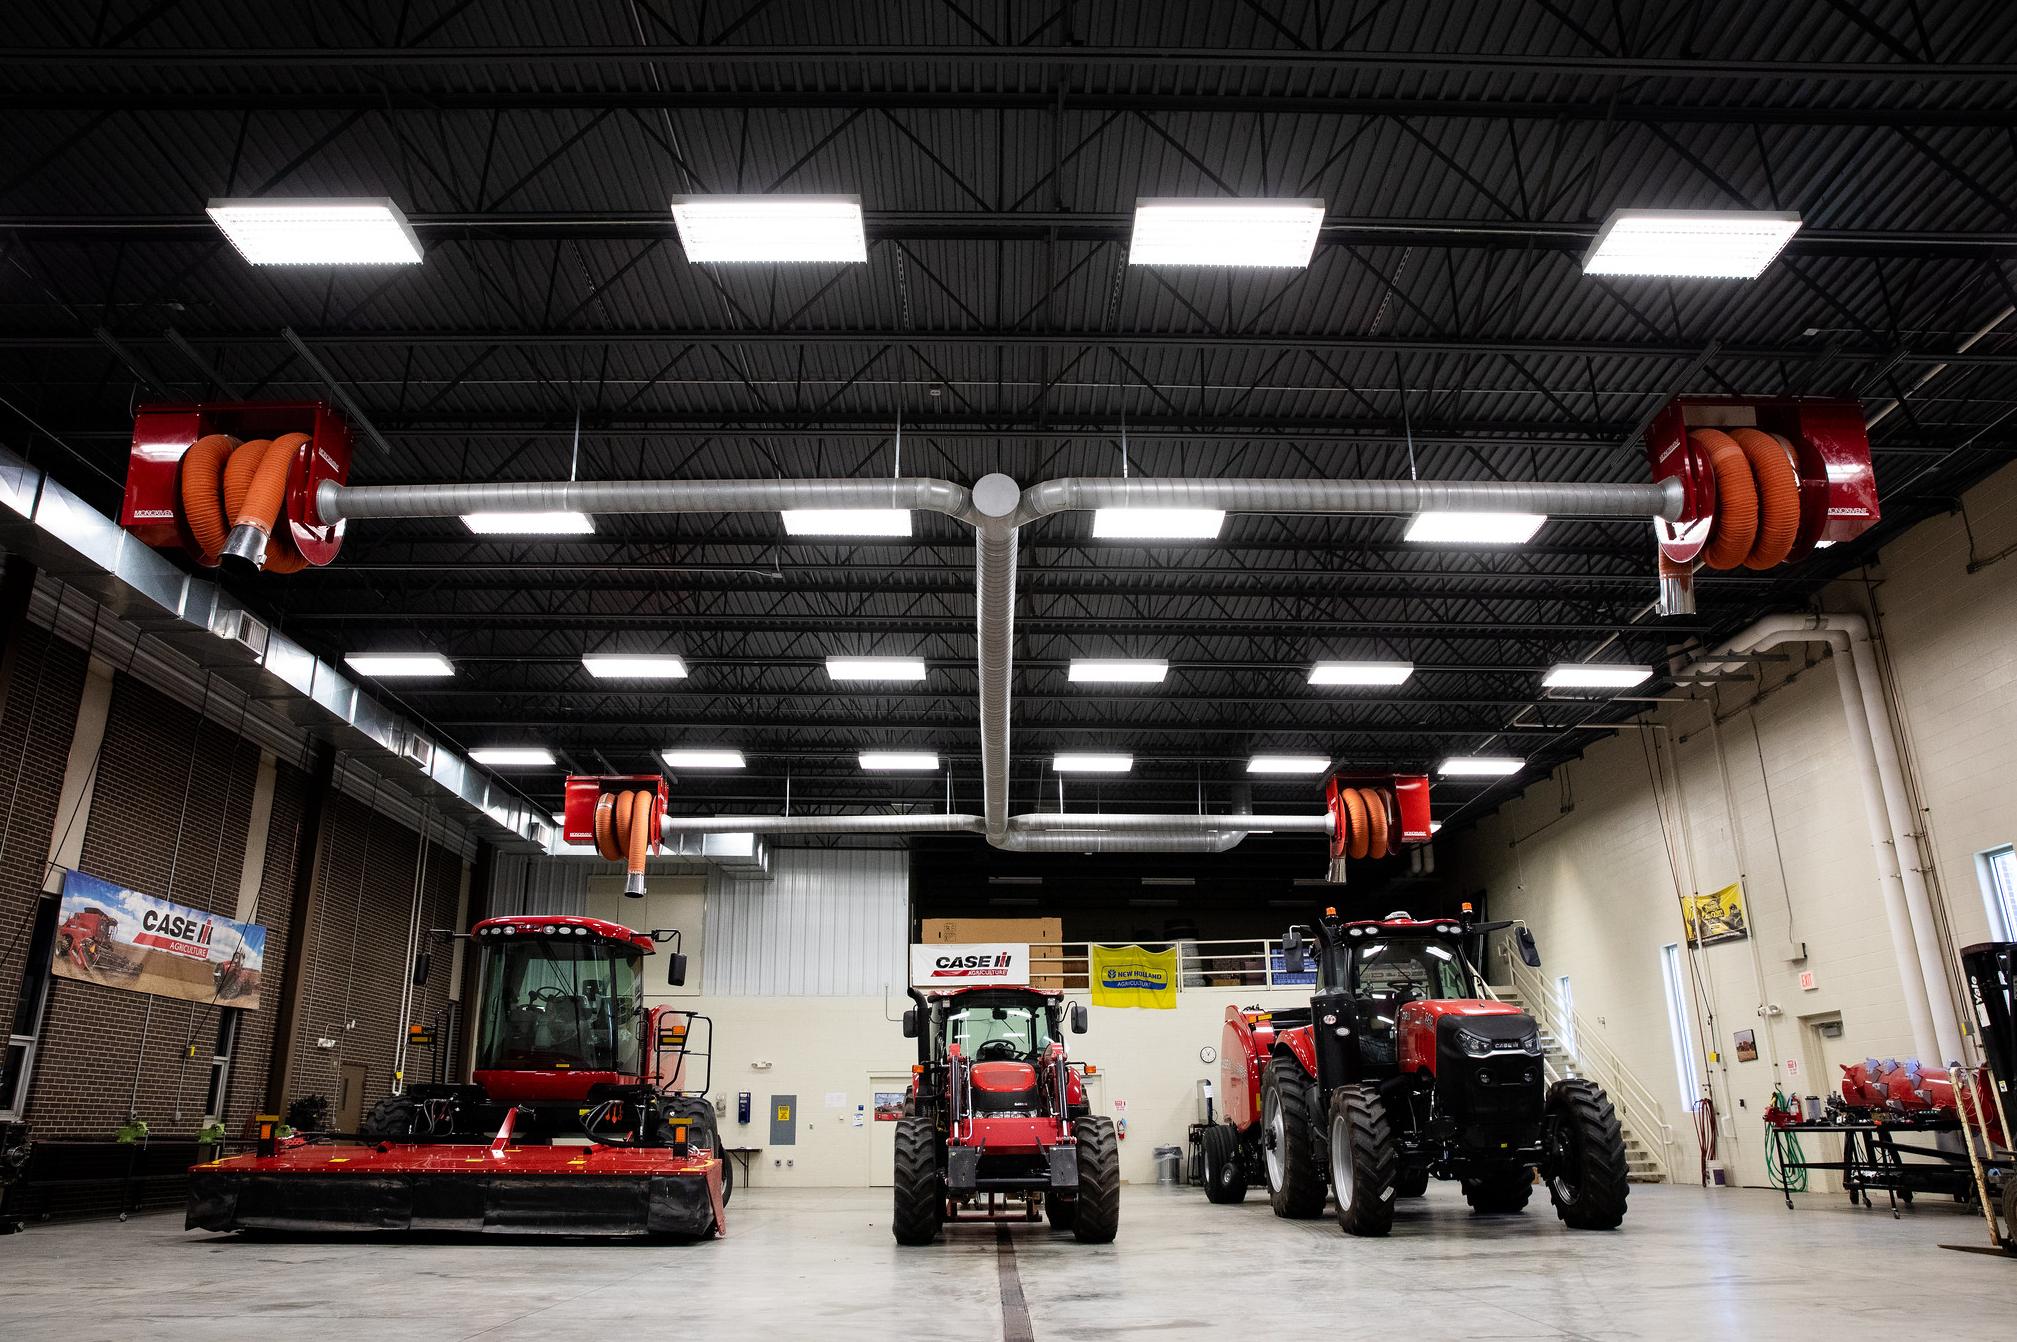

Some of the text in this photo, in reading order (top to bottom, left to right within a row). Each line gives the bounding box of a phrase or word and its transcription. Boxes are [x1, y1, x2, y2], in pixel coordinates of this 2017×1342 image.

[143, 910, 197, 941] CASE
[169, 941, 206, 957] AGRICULTURE
[935, 955, 992, 969] CASE
[1117, 970, 1162, 980] NEW HOLLAND
[1971, 975, 1983, 1005] Yale
